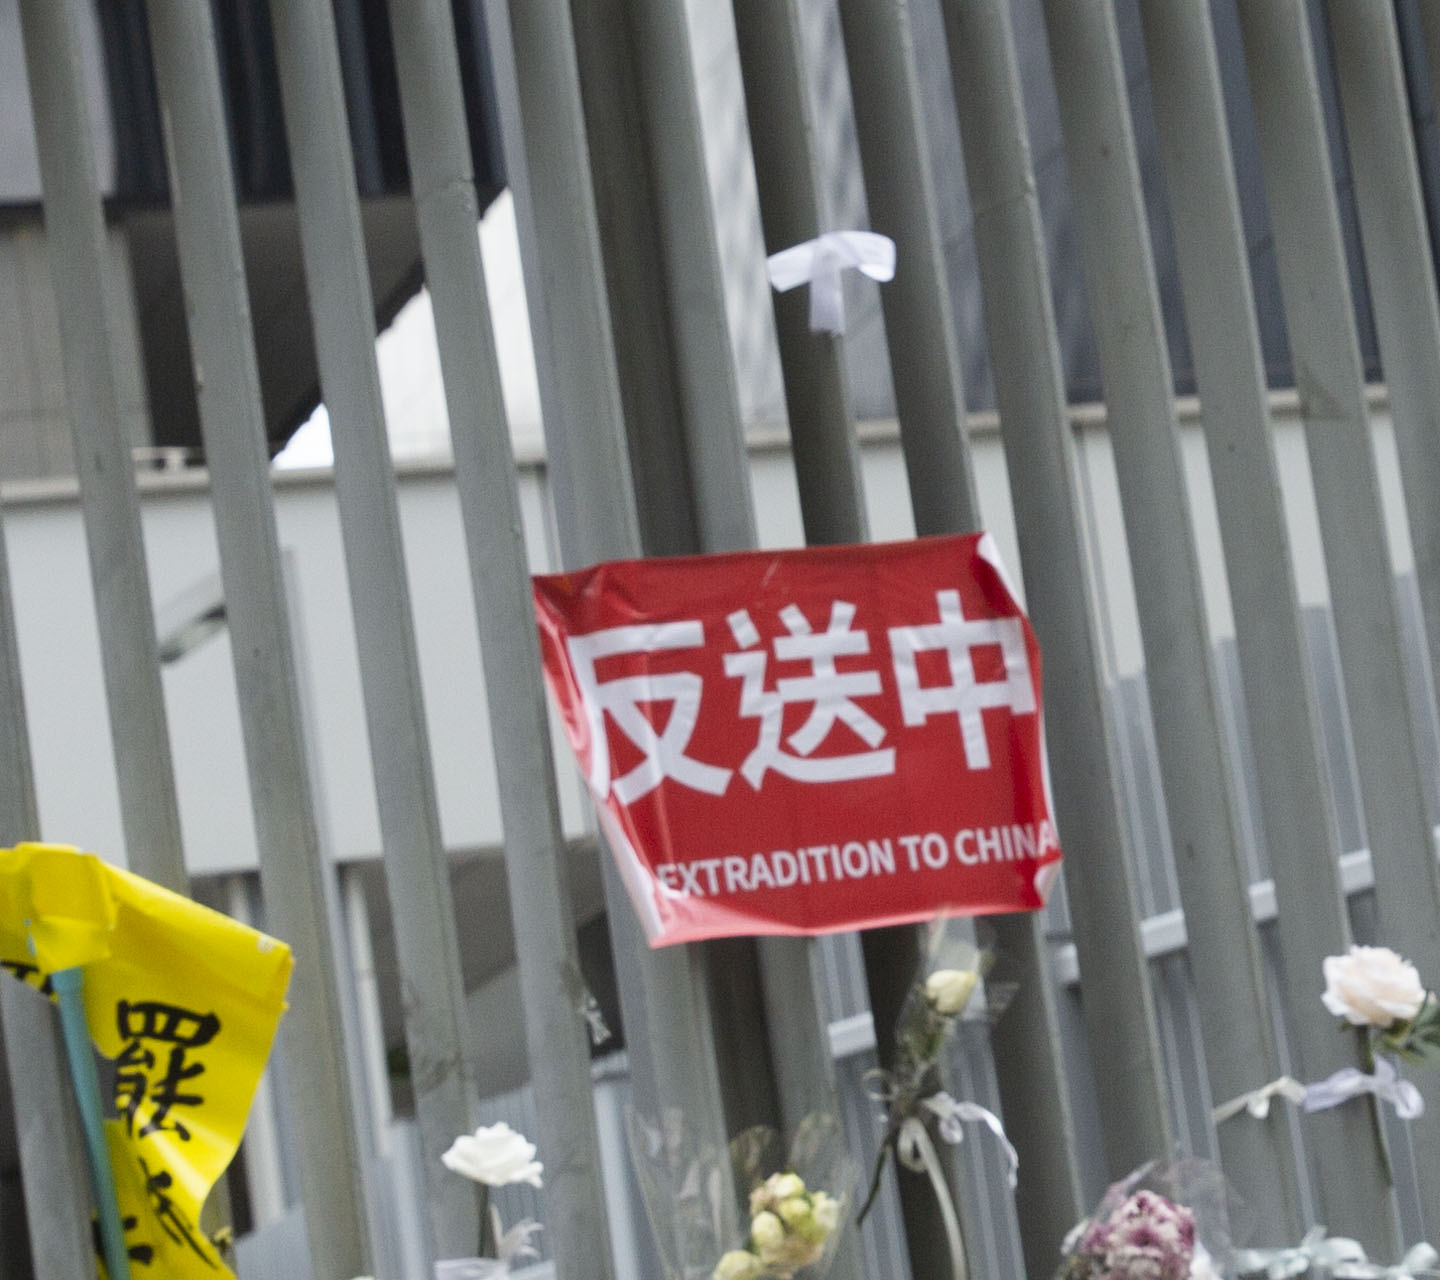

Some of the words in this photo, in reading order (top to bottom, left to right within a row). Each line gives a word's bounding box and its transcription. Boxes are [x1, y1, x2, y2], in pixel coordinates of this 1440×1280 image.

[566, 589, 1038, 806] 反送中
[655, 837, 894, 899] EXTRADITION
[899, 830, 950, 872] TO
[953, 818, 1058, 868] CHINA
